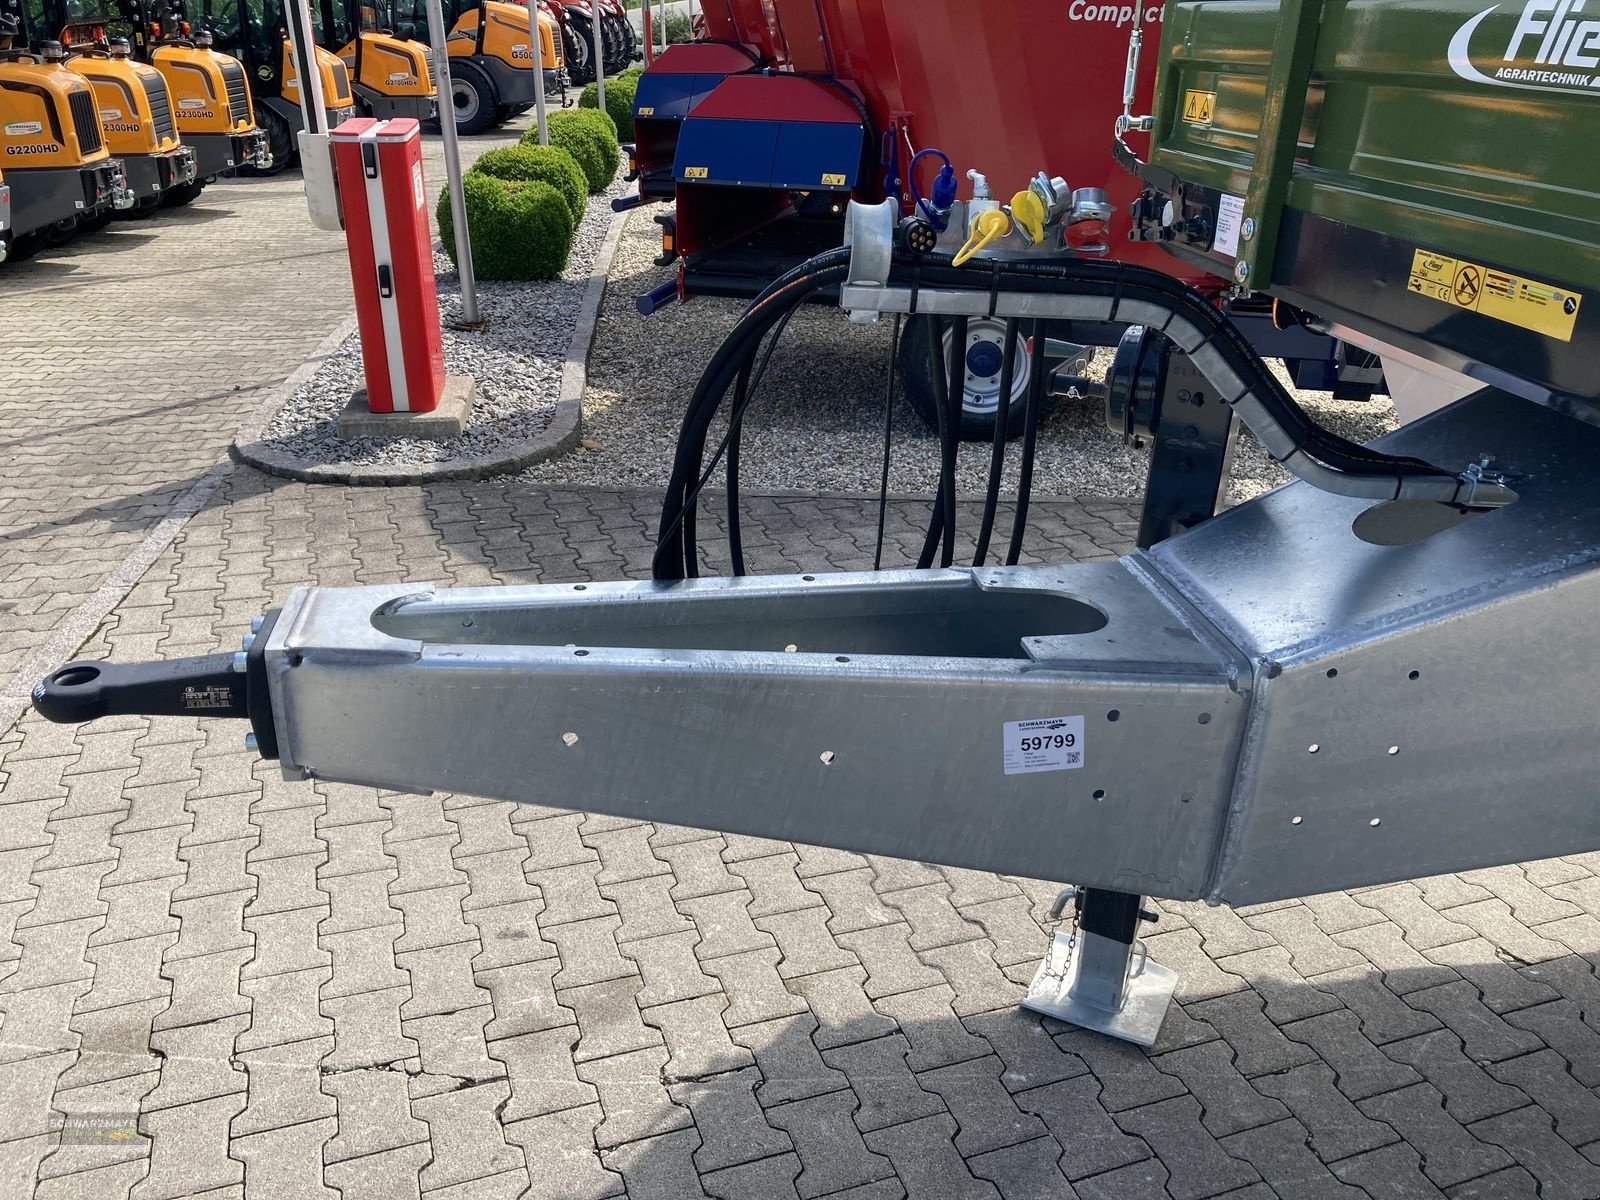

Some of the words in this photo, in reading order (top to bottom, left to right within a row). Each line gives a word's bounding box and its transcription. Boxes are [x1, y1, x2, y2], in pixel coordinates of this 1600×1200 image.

[1495, 67, 1591, 86] AGRARTECHNIK
[175, 110, 214, 118] G2300HD
[103, 123, 140, 132] 2300HD
[6, 144, 59, 155] G2200HD
[1018, 719, 1063, 728] SCHWARZMAYR
[1021, 733, 1075, 751] 59799
